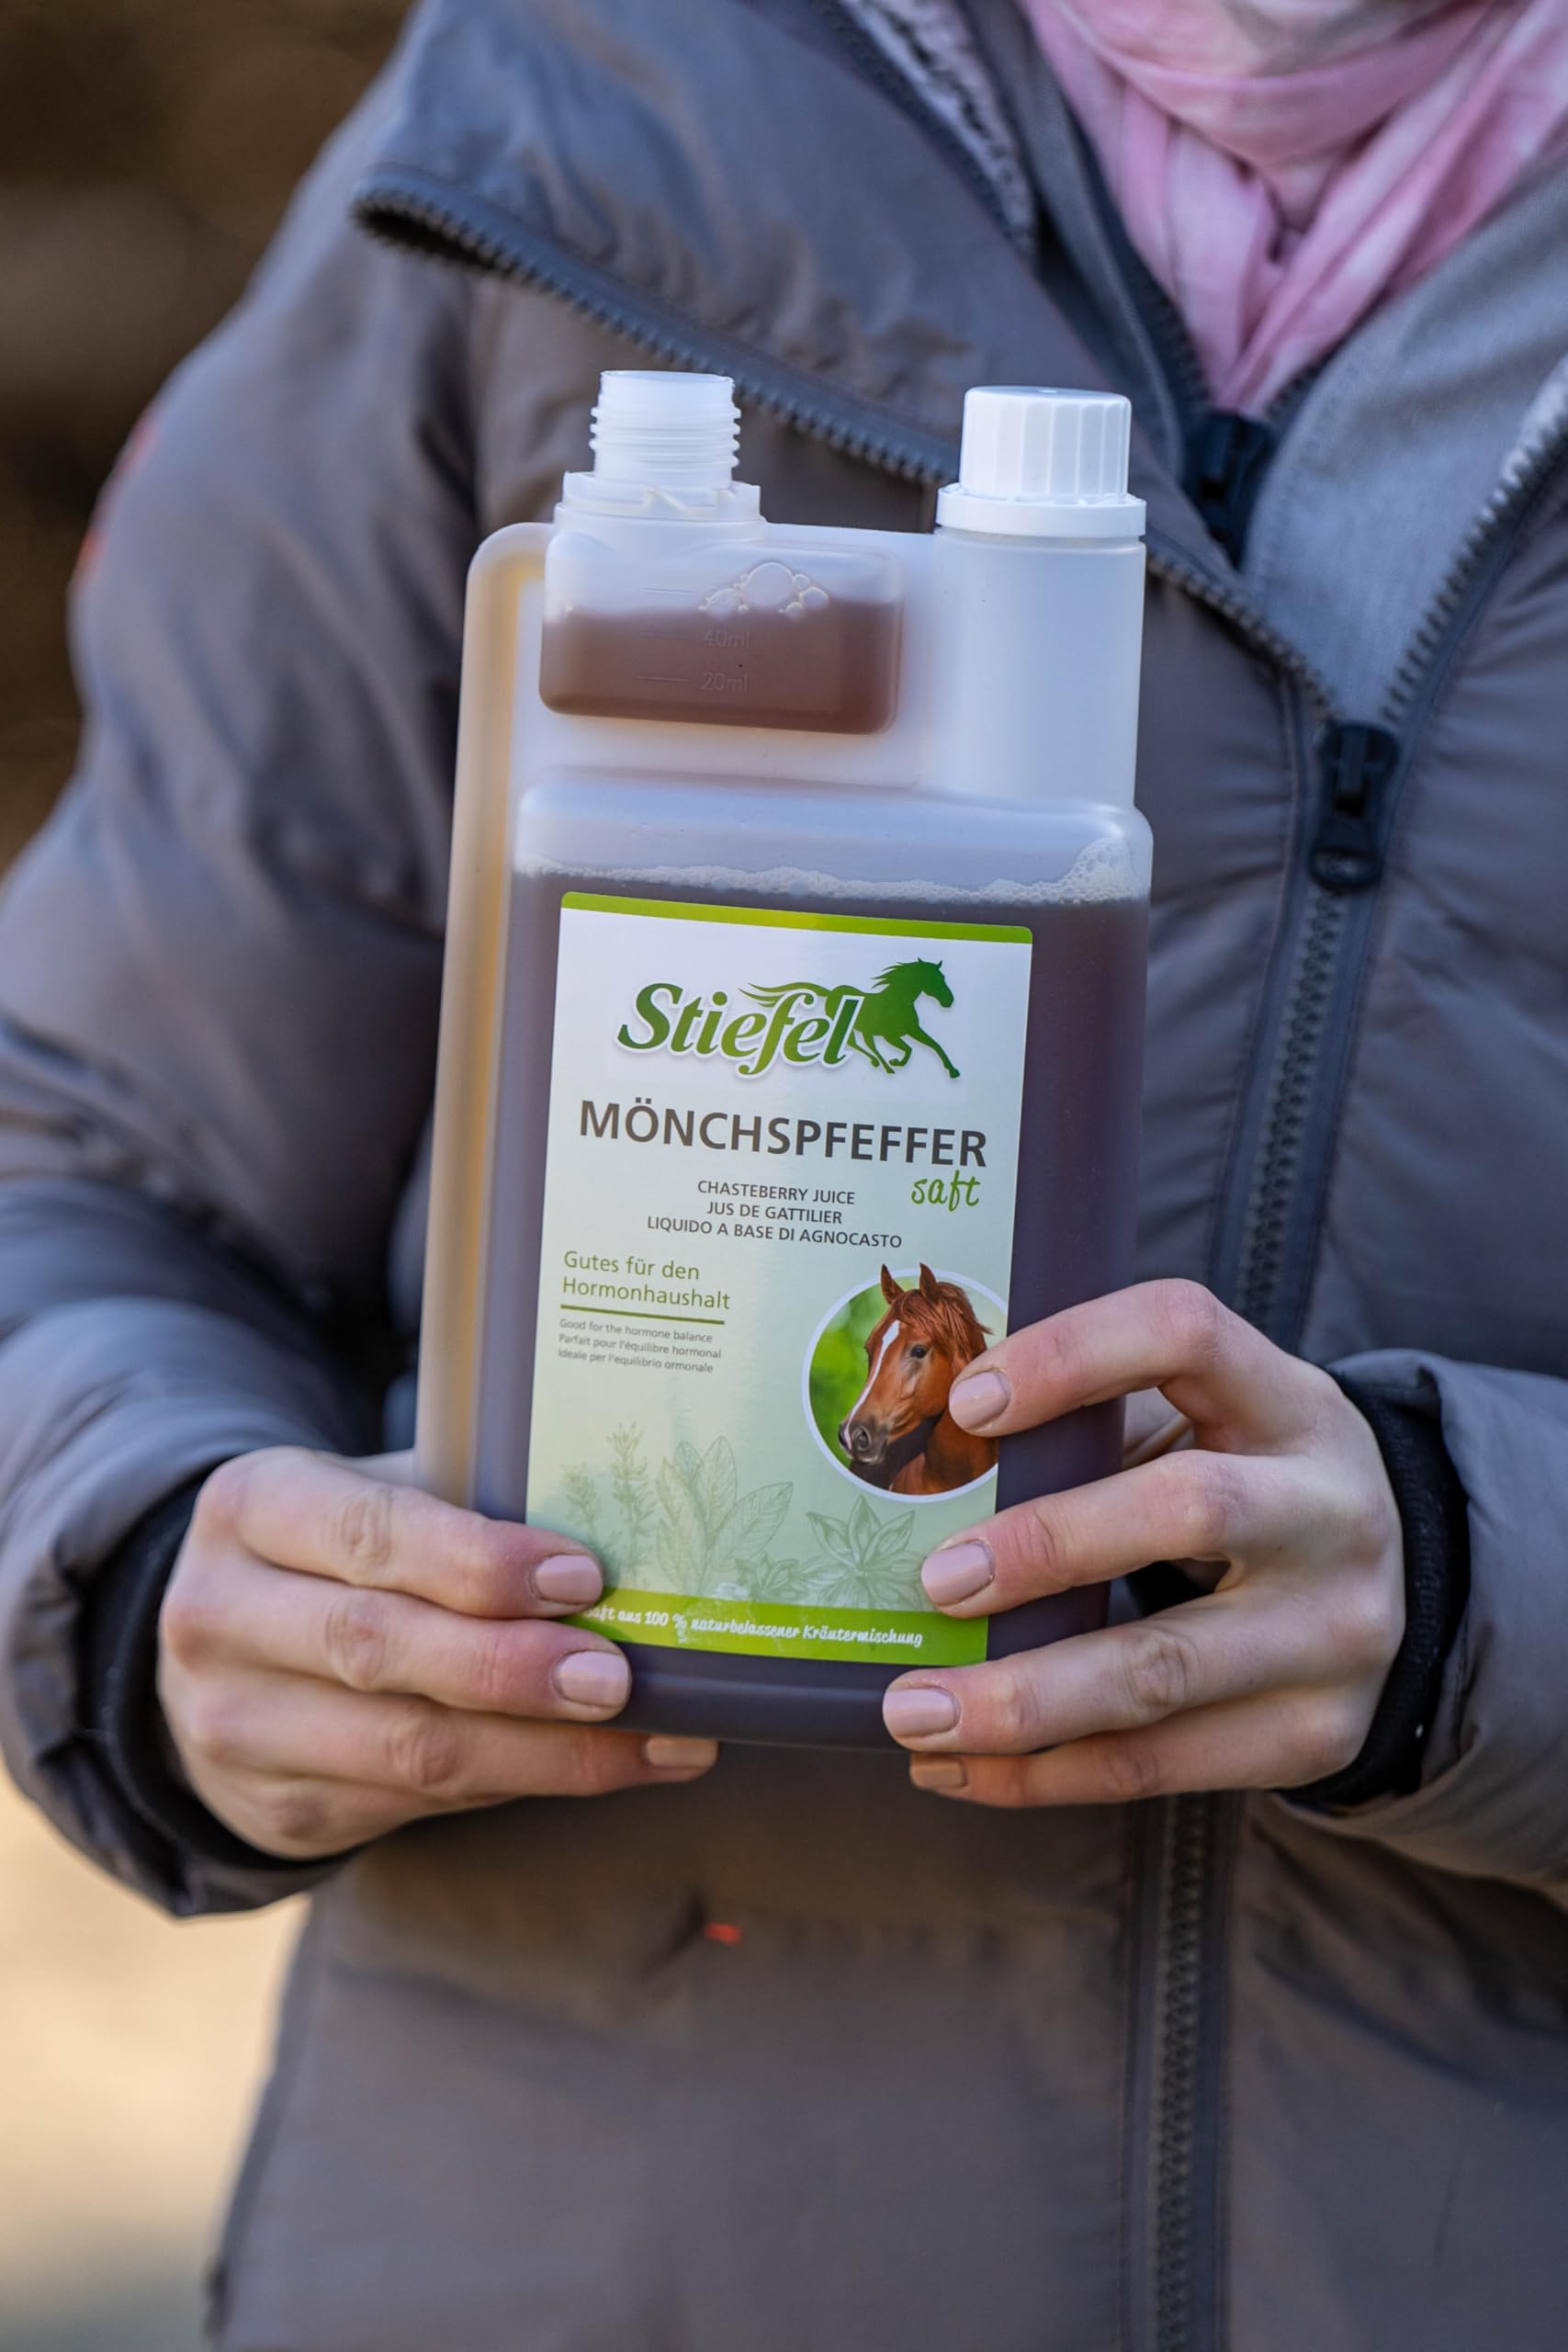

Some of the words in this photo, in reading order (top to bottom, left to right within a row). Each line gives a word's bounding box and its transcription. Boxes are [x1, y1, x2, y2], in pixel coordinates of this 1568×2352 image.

[702, 627, 750, 649] 40ml
[701, 672, 750, 692] 20ml
[617, 982, 860, 1076] Stiefel
[580, 1097, 987, 1168] MÖNCHSPFEFFER
[697, 1181, 807, 1202] CHASTEBERRY
[812, 1189, 855, 1205] JUICE
[910, 1170, 980, 1212] saft
[706, 1201, 734, 1217] JUS
[739, 1204, 761, 1218] DE
[764, 1206, 842, 1224] GATTILIER
[647, 1217, 712, 1235] LIQUIDO
[716, 1220, 729, 1236] A
[734, 1222, 773, 1240] BASE
[779, 1225, 795, 1241] DI
[799, 1227, 903, 1249] AGNOCASTO
[563, 1250, 619, 1273] Gutes
[626, 1256, 655, 1276] für
[661, 1261, 700, 1280] den
[562, 1276, 731, 1310] Hormonhaushalt
[559, 1318, 586, 1330] Good
[589, 1321, 604, 1331] for
[605, 1324, 623, 1334] the
[625, 1326, 671, 1339] hormone
[673, 1330, 713, 1343] balance
[558, 1333, 591, 1346] Parfait
[592, 1339, 617, 1349] pour
[671, 1345, 722, 1359] hormonal
[558, 1348, 588, 1360] Ideale
[589, 1353, 606, 1363] per
[608, 1354, 662, 1369] l'equilibrio
[664, 1362, 714, 1374] ormonale
[616, 1610, 642, 1624] aus
[644, 1610, 669, 1626] 100
[671, 1613, 688, 1630] %
[690, 1618, 800, 1639] naturbelassener
[802, 1624, 924, 1648] Kräutermischung
